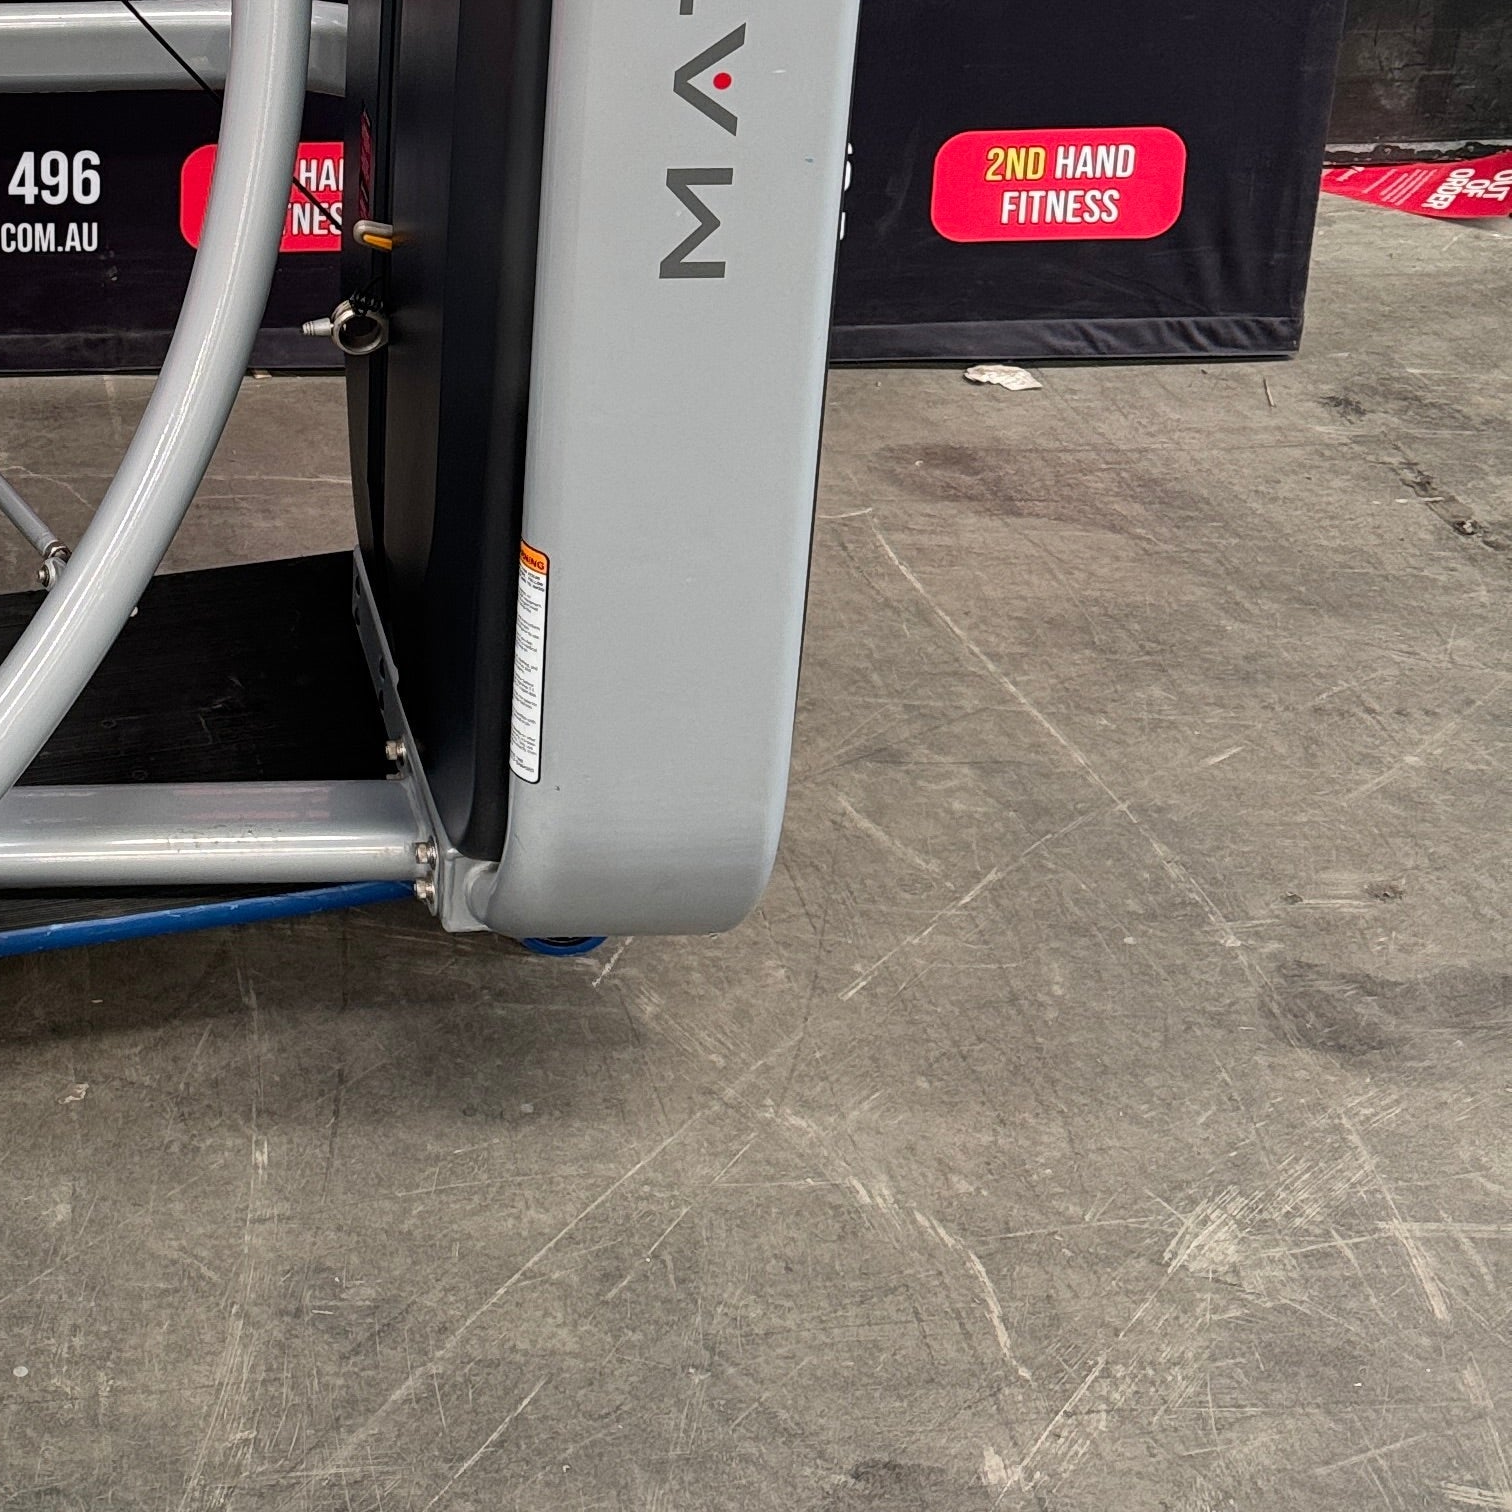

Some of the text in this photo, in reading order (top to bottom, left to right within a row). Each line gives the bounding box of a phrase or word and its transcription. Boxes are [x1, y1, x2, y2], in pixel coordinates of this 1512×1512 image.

[8, 149, 101, 205] 496
[985, 144, 1136, 181] 2ND HAND
[1001, 189, 1120, 224] FITNESS
[1421, 168, 1476, 210] ORDER
[1461, 178, 1491, 198] OF
